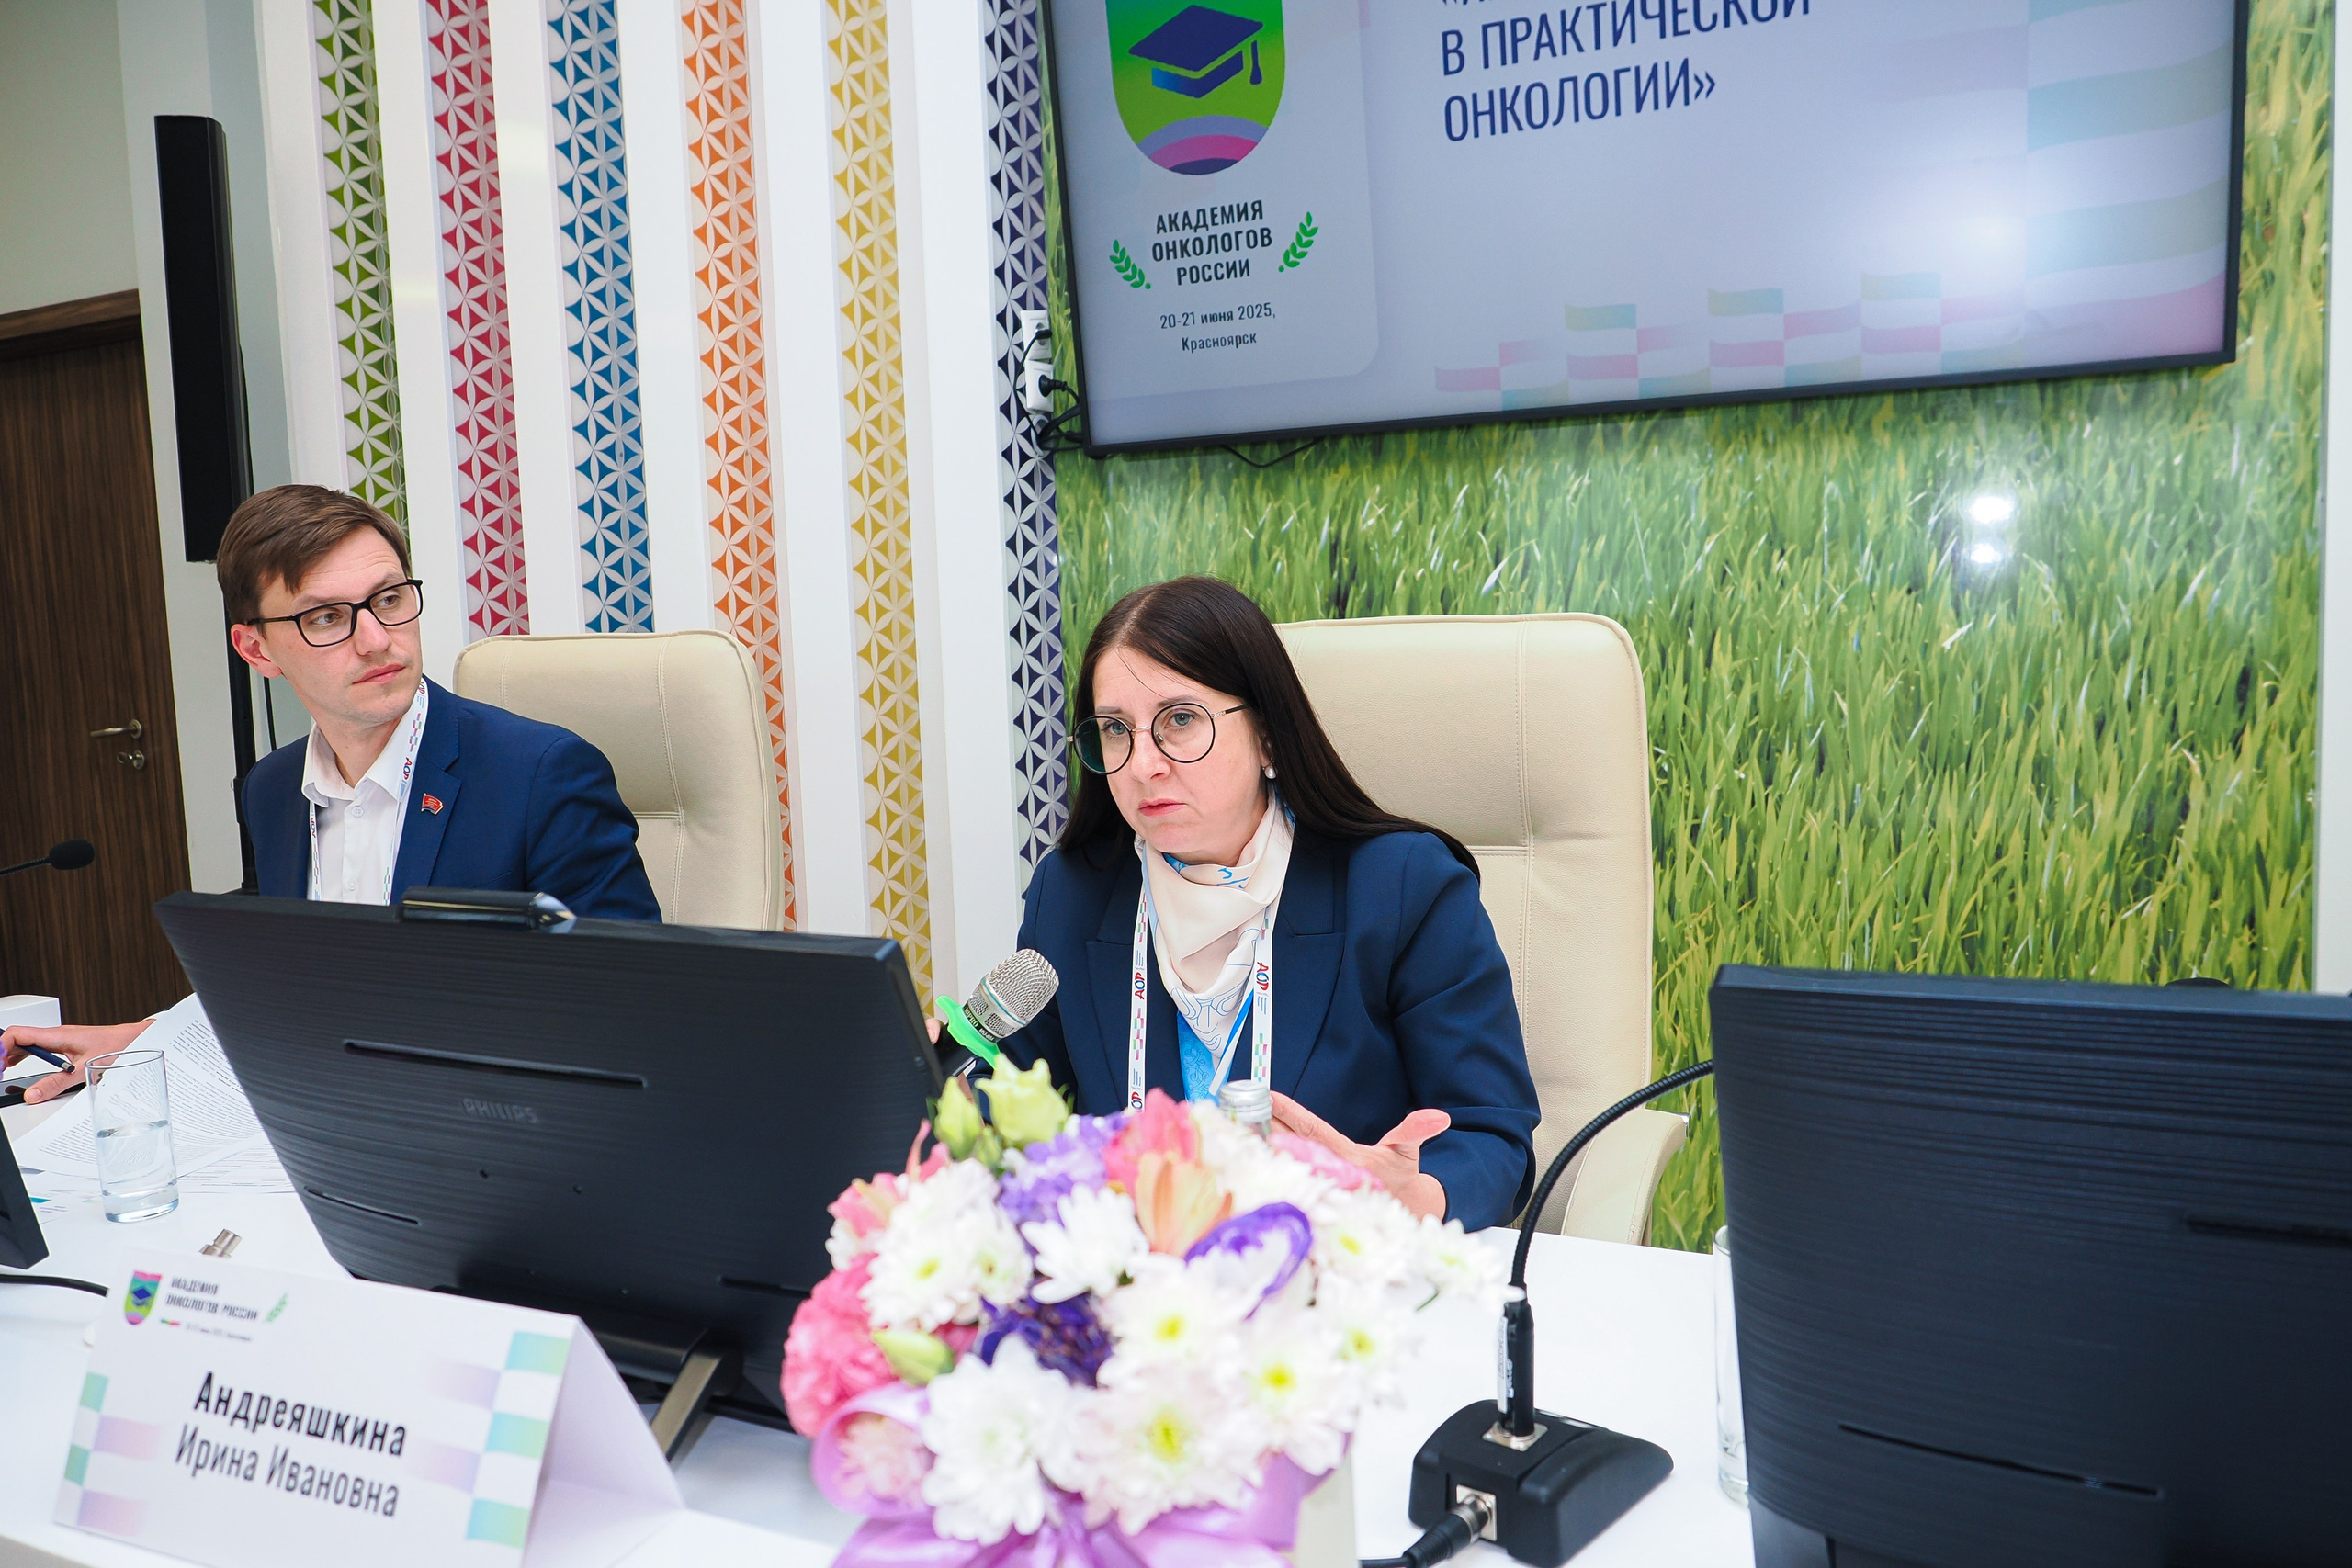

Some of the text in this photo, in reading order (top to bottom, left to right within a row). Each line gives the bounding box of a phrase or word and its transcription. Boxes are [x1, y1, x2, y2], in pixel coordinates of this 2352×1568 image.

[1442, 0, 1810, 76] В ПРАКТИЧЕСК
[1444, 58, 1716, 141] ОНКОЛОГИИ»
[1156, 199, 1263, 234] АКАДЕМИЯ
[1151, 227, 1273, 263] ОНКОЛОГОВ
[1176, 258, 1250, 286] РОССИИ
[1159, 302, 1276, 329] 20-21 июня 2025,
[1182, 333, 1257, 354] Красноярск
[461, 1098, 538, 1123] PHILIPS
[1130, 1091, 1143, 1112] ОР
[193, 1371, 407, 1457] Андреяшкина
[175, 1423, 401, 1518] Ирина Ивановна
